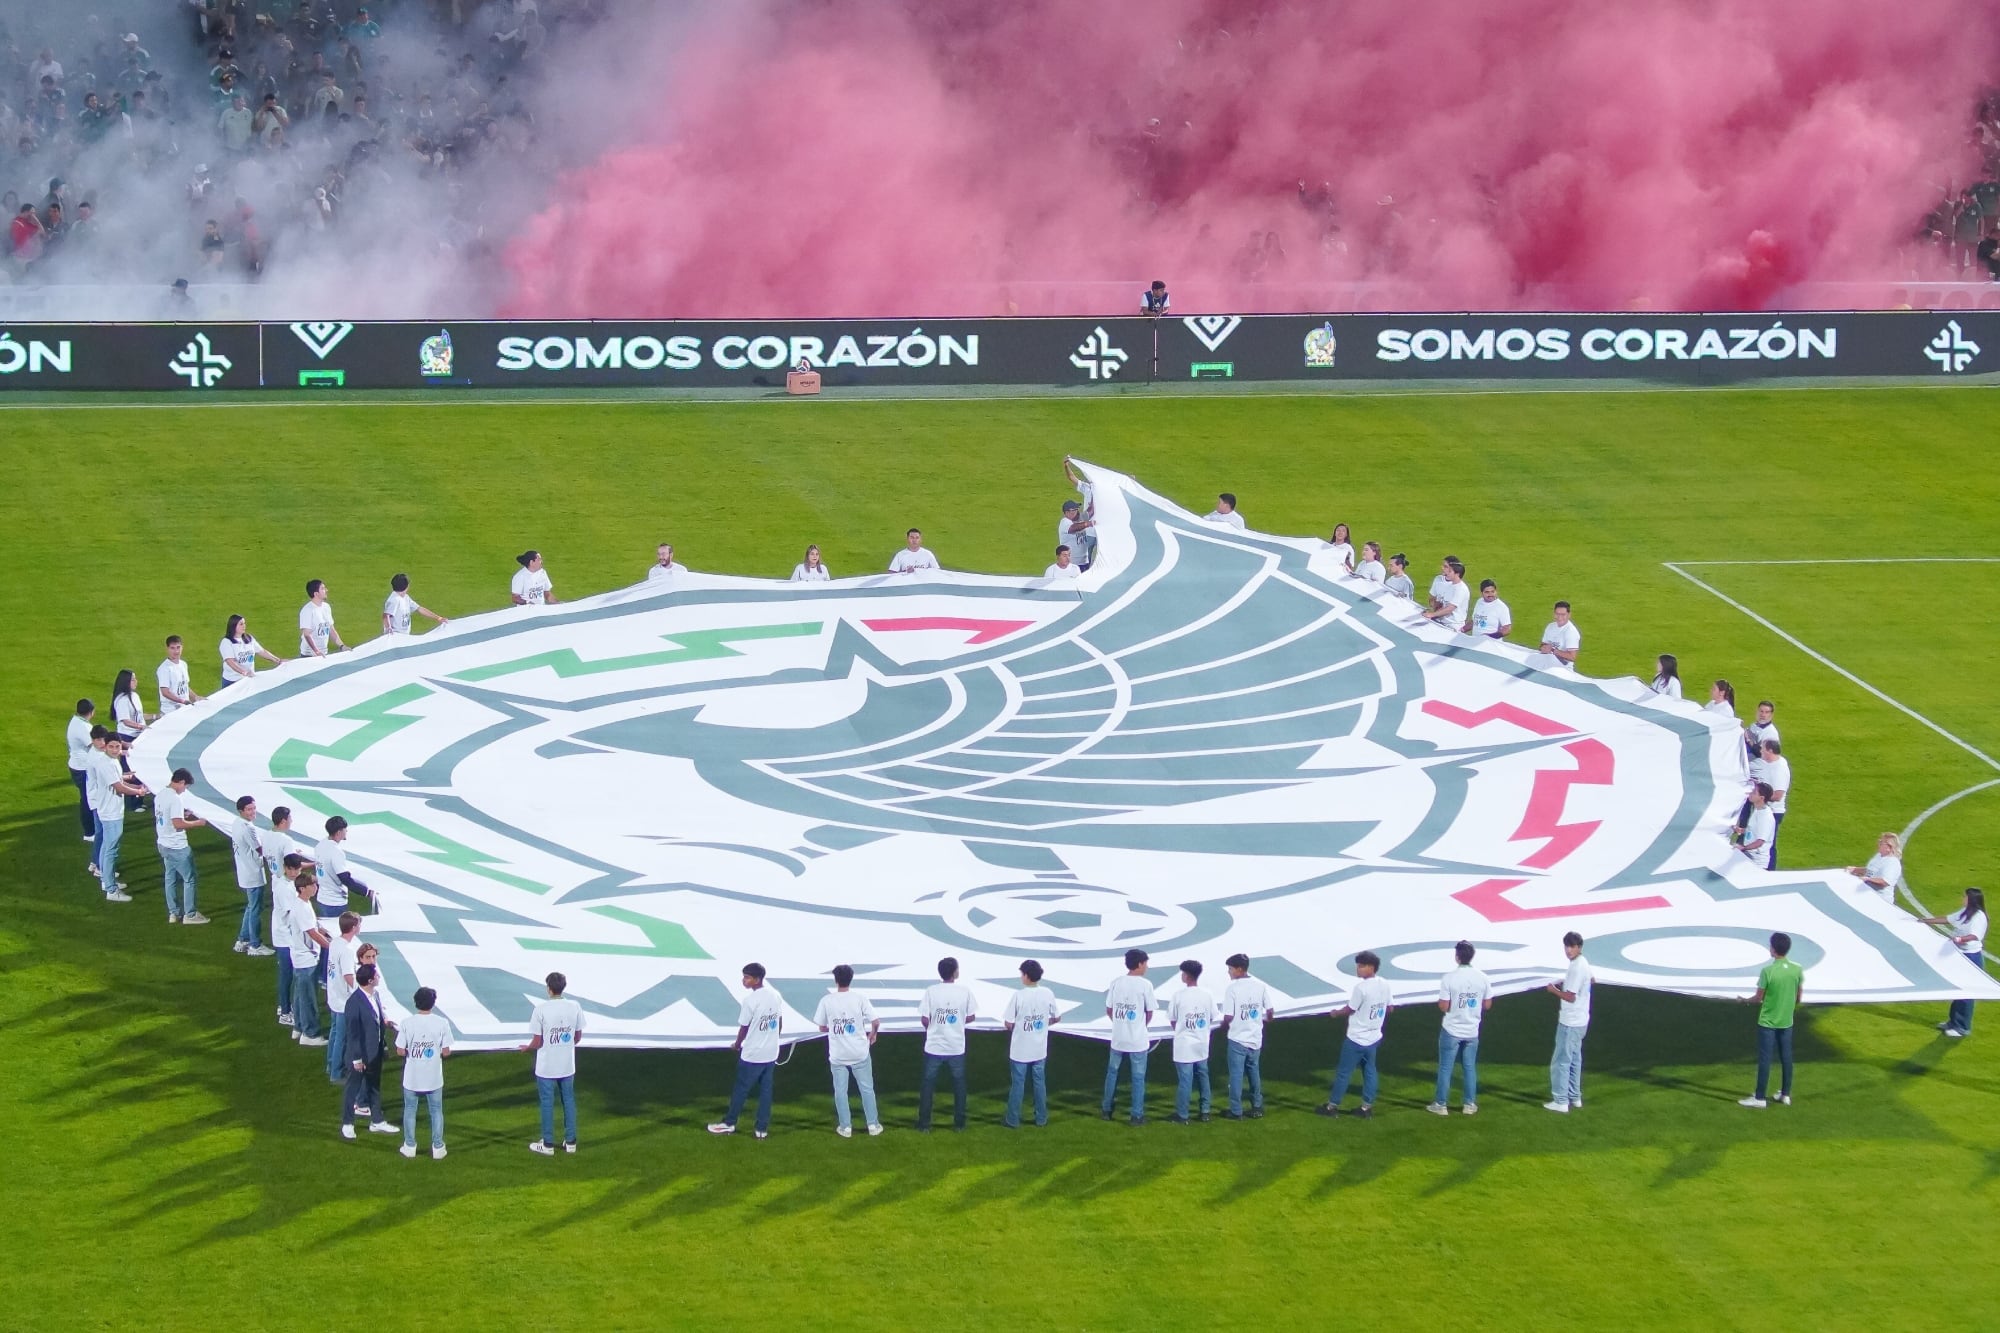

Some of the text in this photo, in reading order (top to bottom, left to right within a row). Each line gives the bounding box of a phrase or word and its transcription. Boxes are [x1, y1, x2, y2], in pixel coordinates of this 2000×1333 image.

[497, 328, 978, 370] SOMOS CORAZÓN
[1376, 321, 1836, 361] SOMOS CORAZÓN
